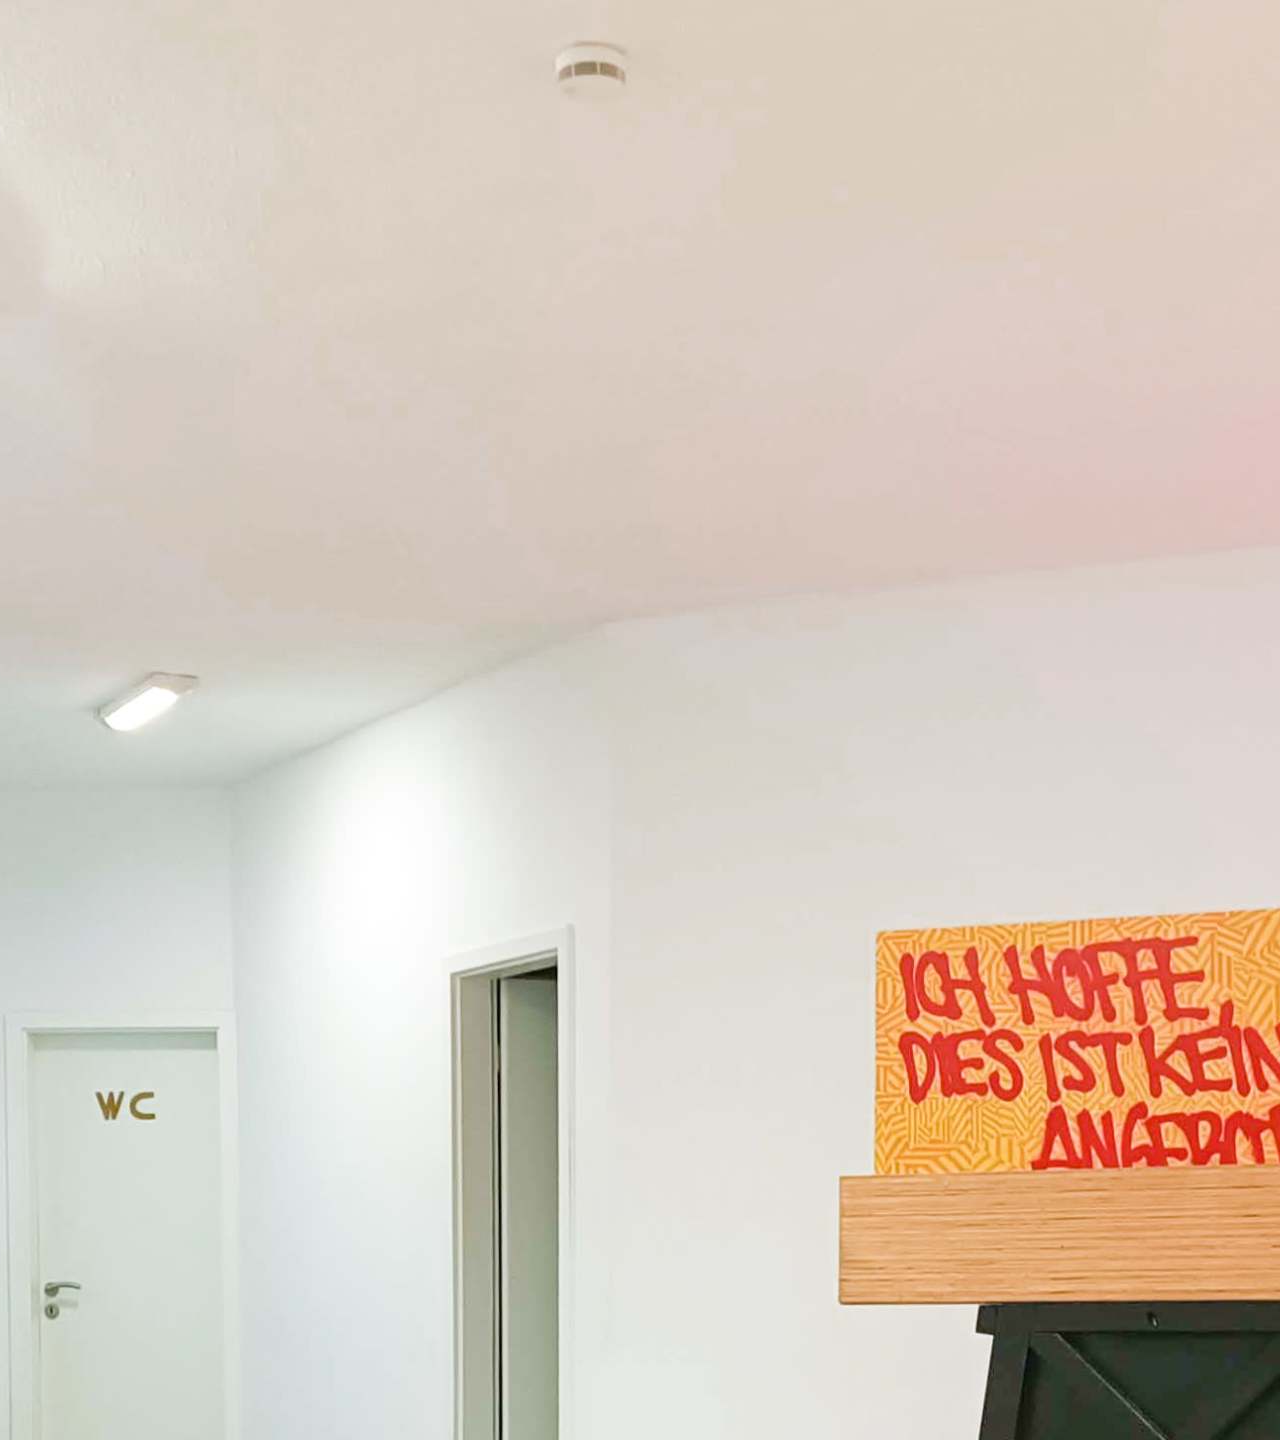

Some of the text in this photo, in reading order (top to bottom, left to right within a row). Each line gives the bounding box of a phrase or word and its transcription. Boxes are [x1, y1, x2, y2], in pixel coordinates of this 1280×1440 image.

[899, 947, 997, 1028] ICH
[897, 1029, 1025, 1104] DIES
[1038, 1030, 1133, 1102] IST
[95, 1091, 156, 1121] WC
